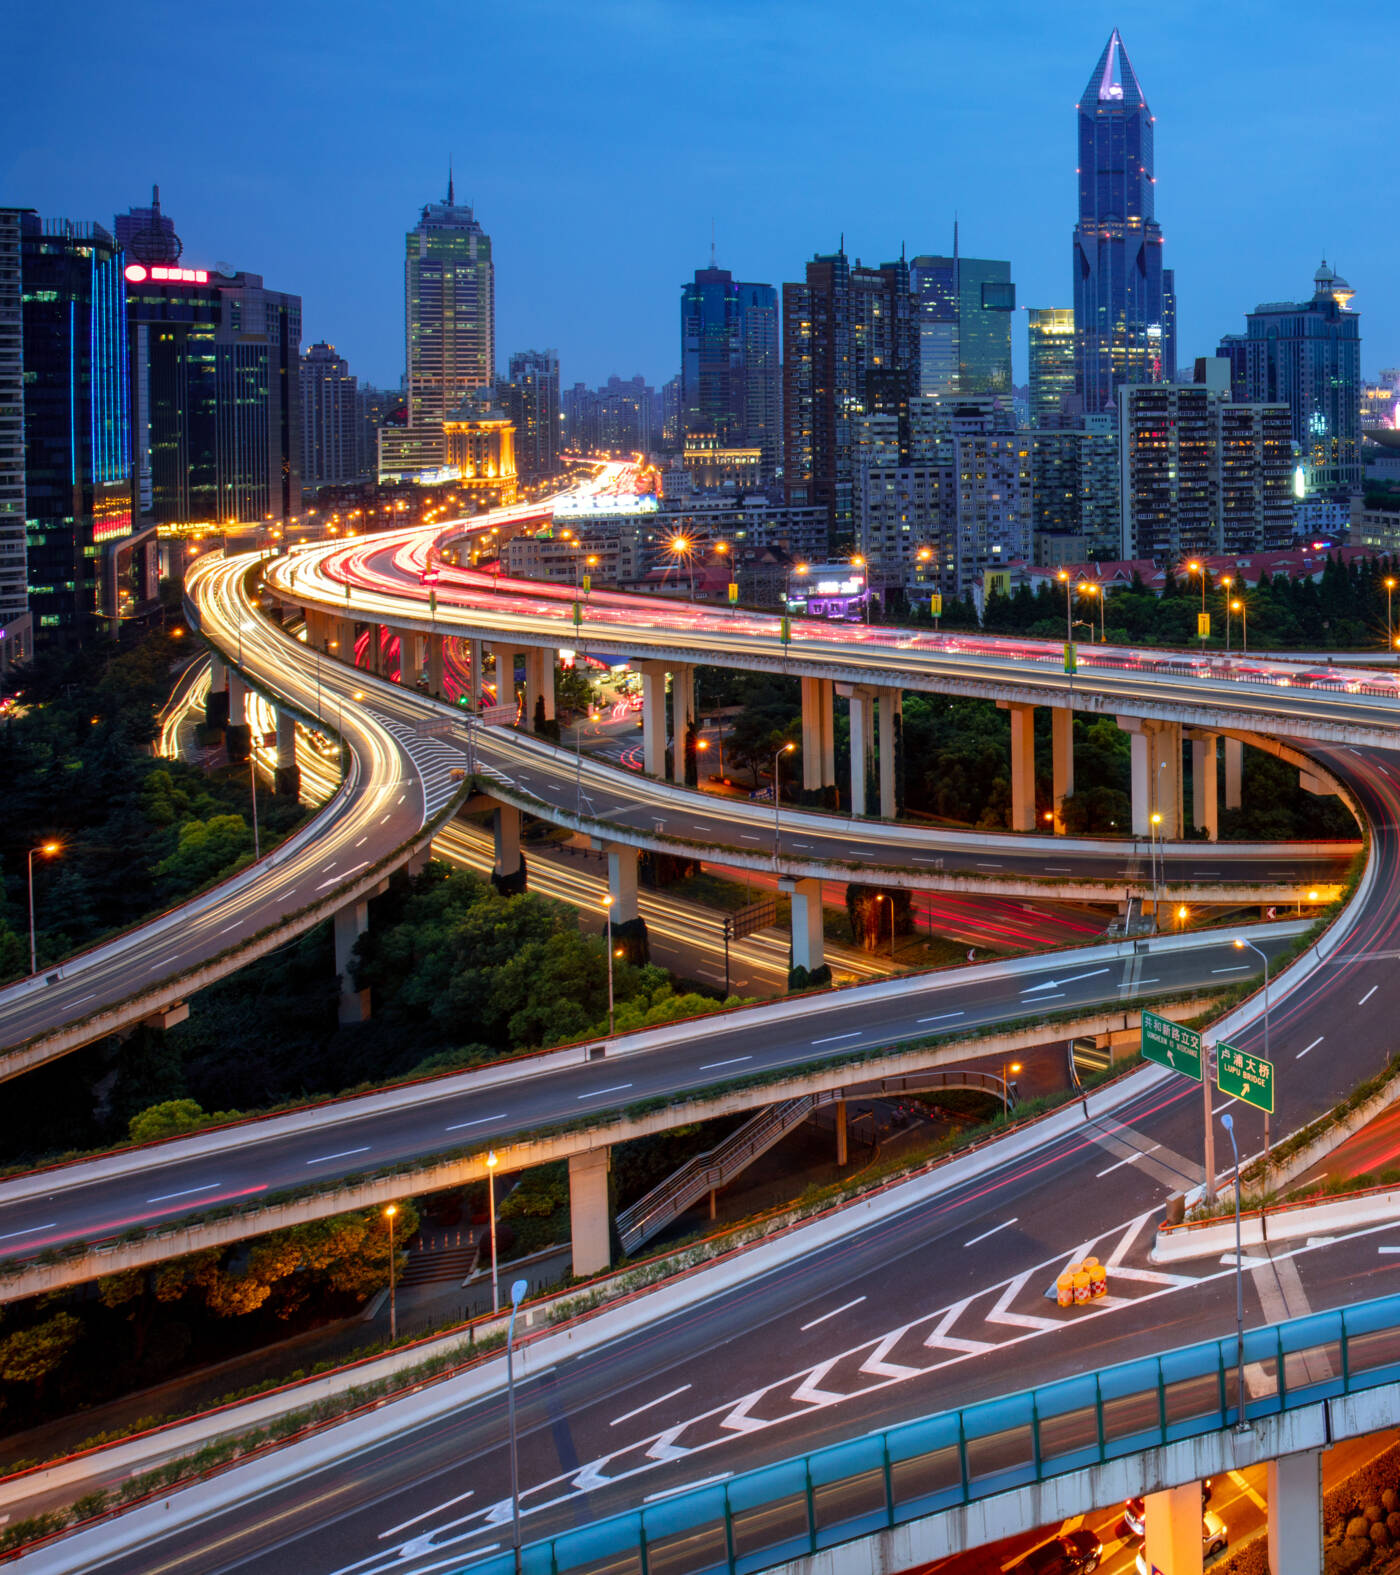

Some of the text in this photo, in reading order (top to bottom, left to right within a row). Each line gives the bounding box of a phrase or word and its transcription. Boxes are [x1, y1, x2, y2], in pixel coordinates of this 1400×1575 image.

[1144, 1015, 1199, 1050] 共和新路立交
[1221, 1048, 1270, 1079] 卢浦大桥
[1224, 1062, 1266, 1088] LUPU BRIDGE
